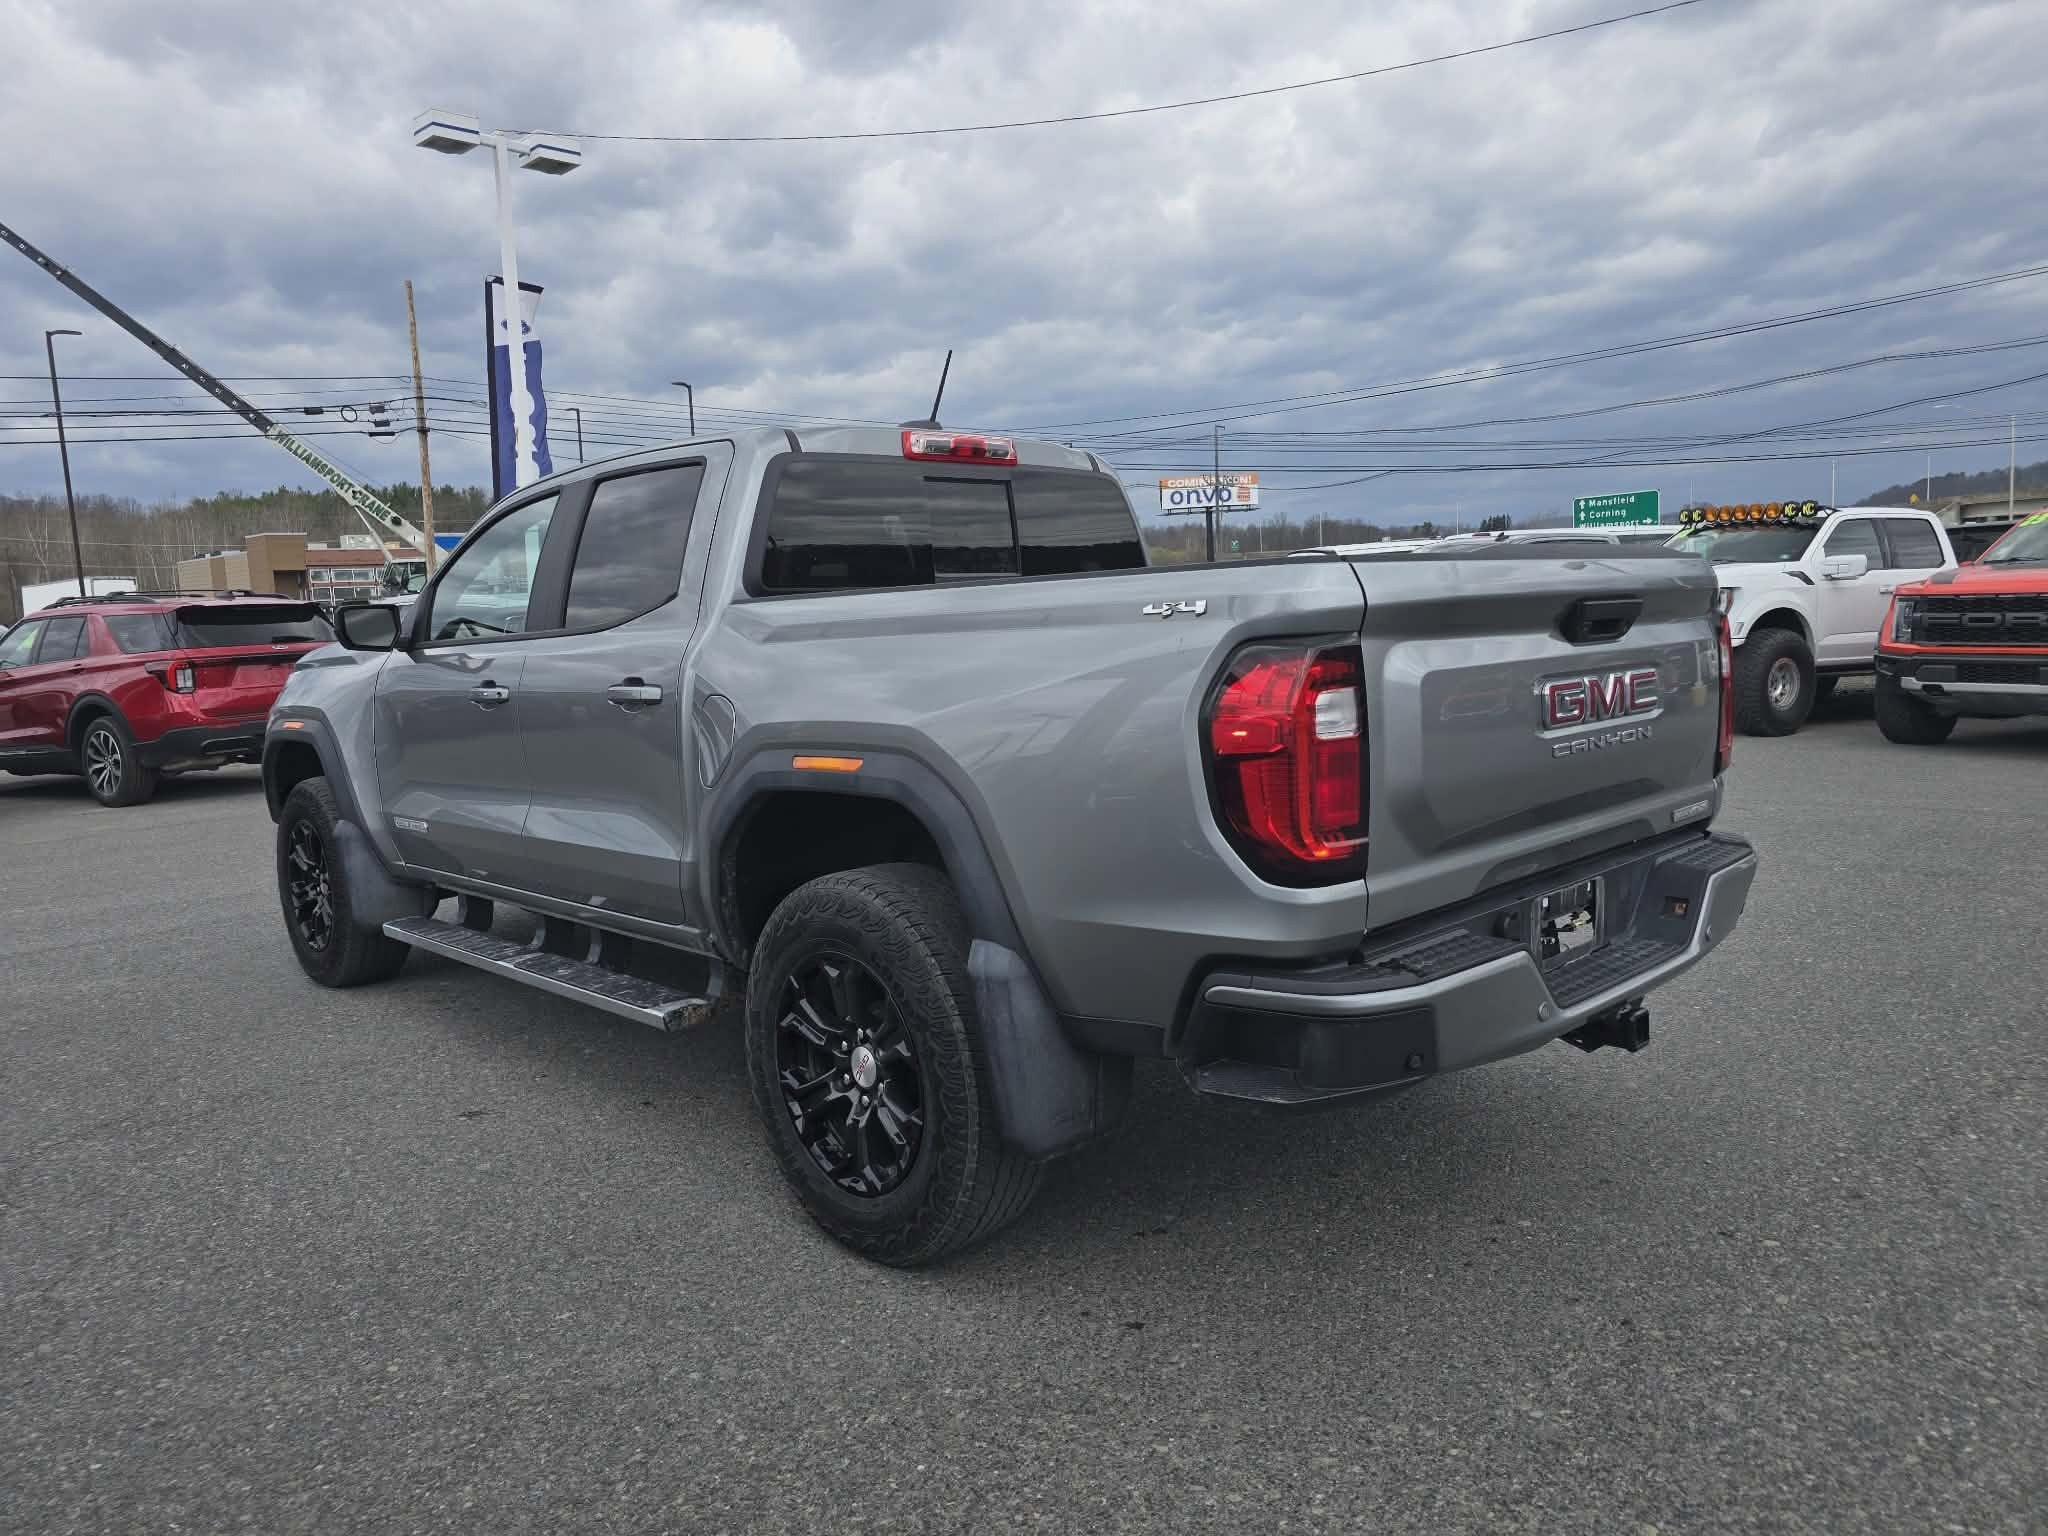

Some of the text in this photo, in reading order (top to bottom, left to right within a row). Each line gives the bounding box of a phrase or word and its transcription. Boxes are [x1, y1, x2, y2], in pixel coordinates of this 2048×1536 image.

[275, 429, 392, 522] WILLIAMSPORT CRANE
[1170, 487, 1232, 505] onvo
[1589, 496, 1635, 507] Mansfield
[1589, 509, 1627, 519] Corning
[1543, 668, 1658, 731] GMC
[1552, 726, 1652, 760] CANYON
